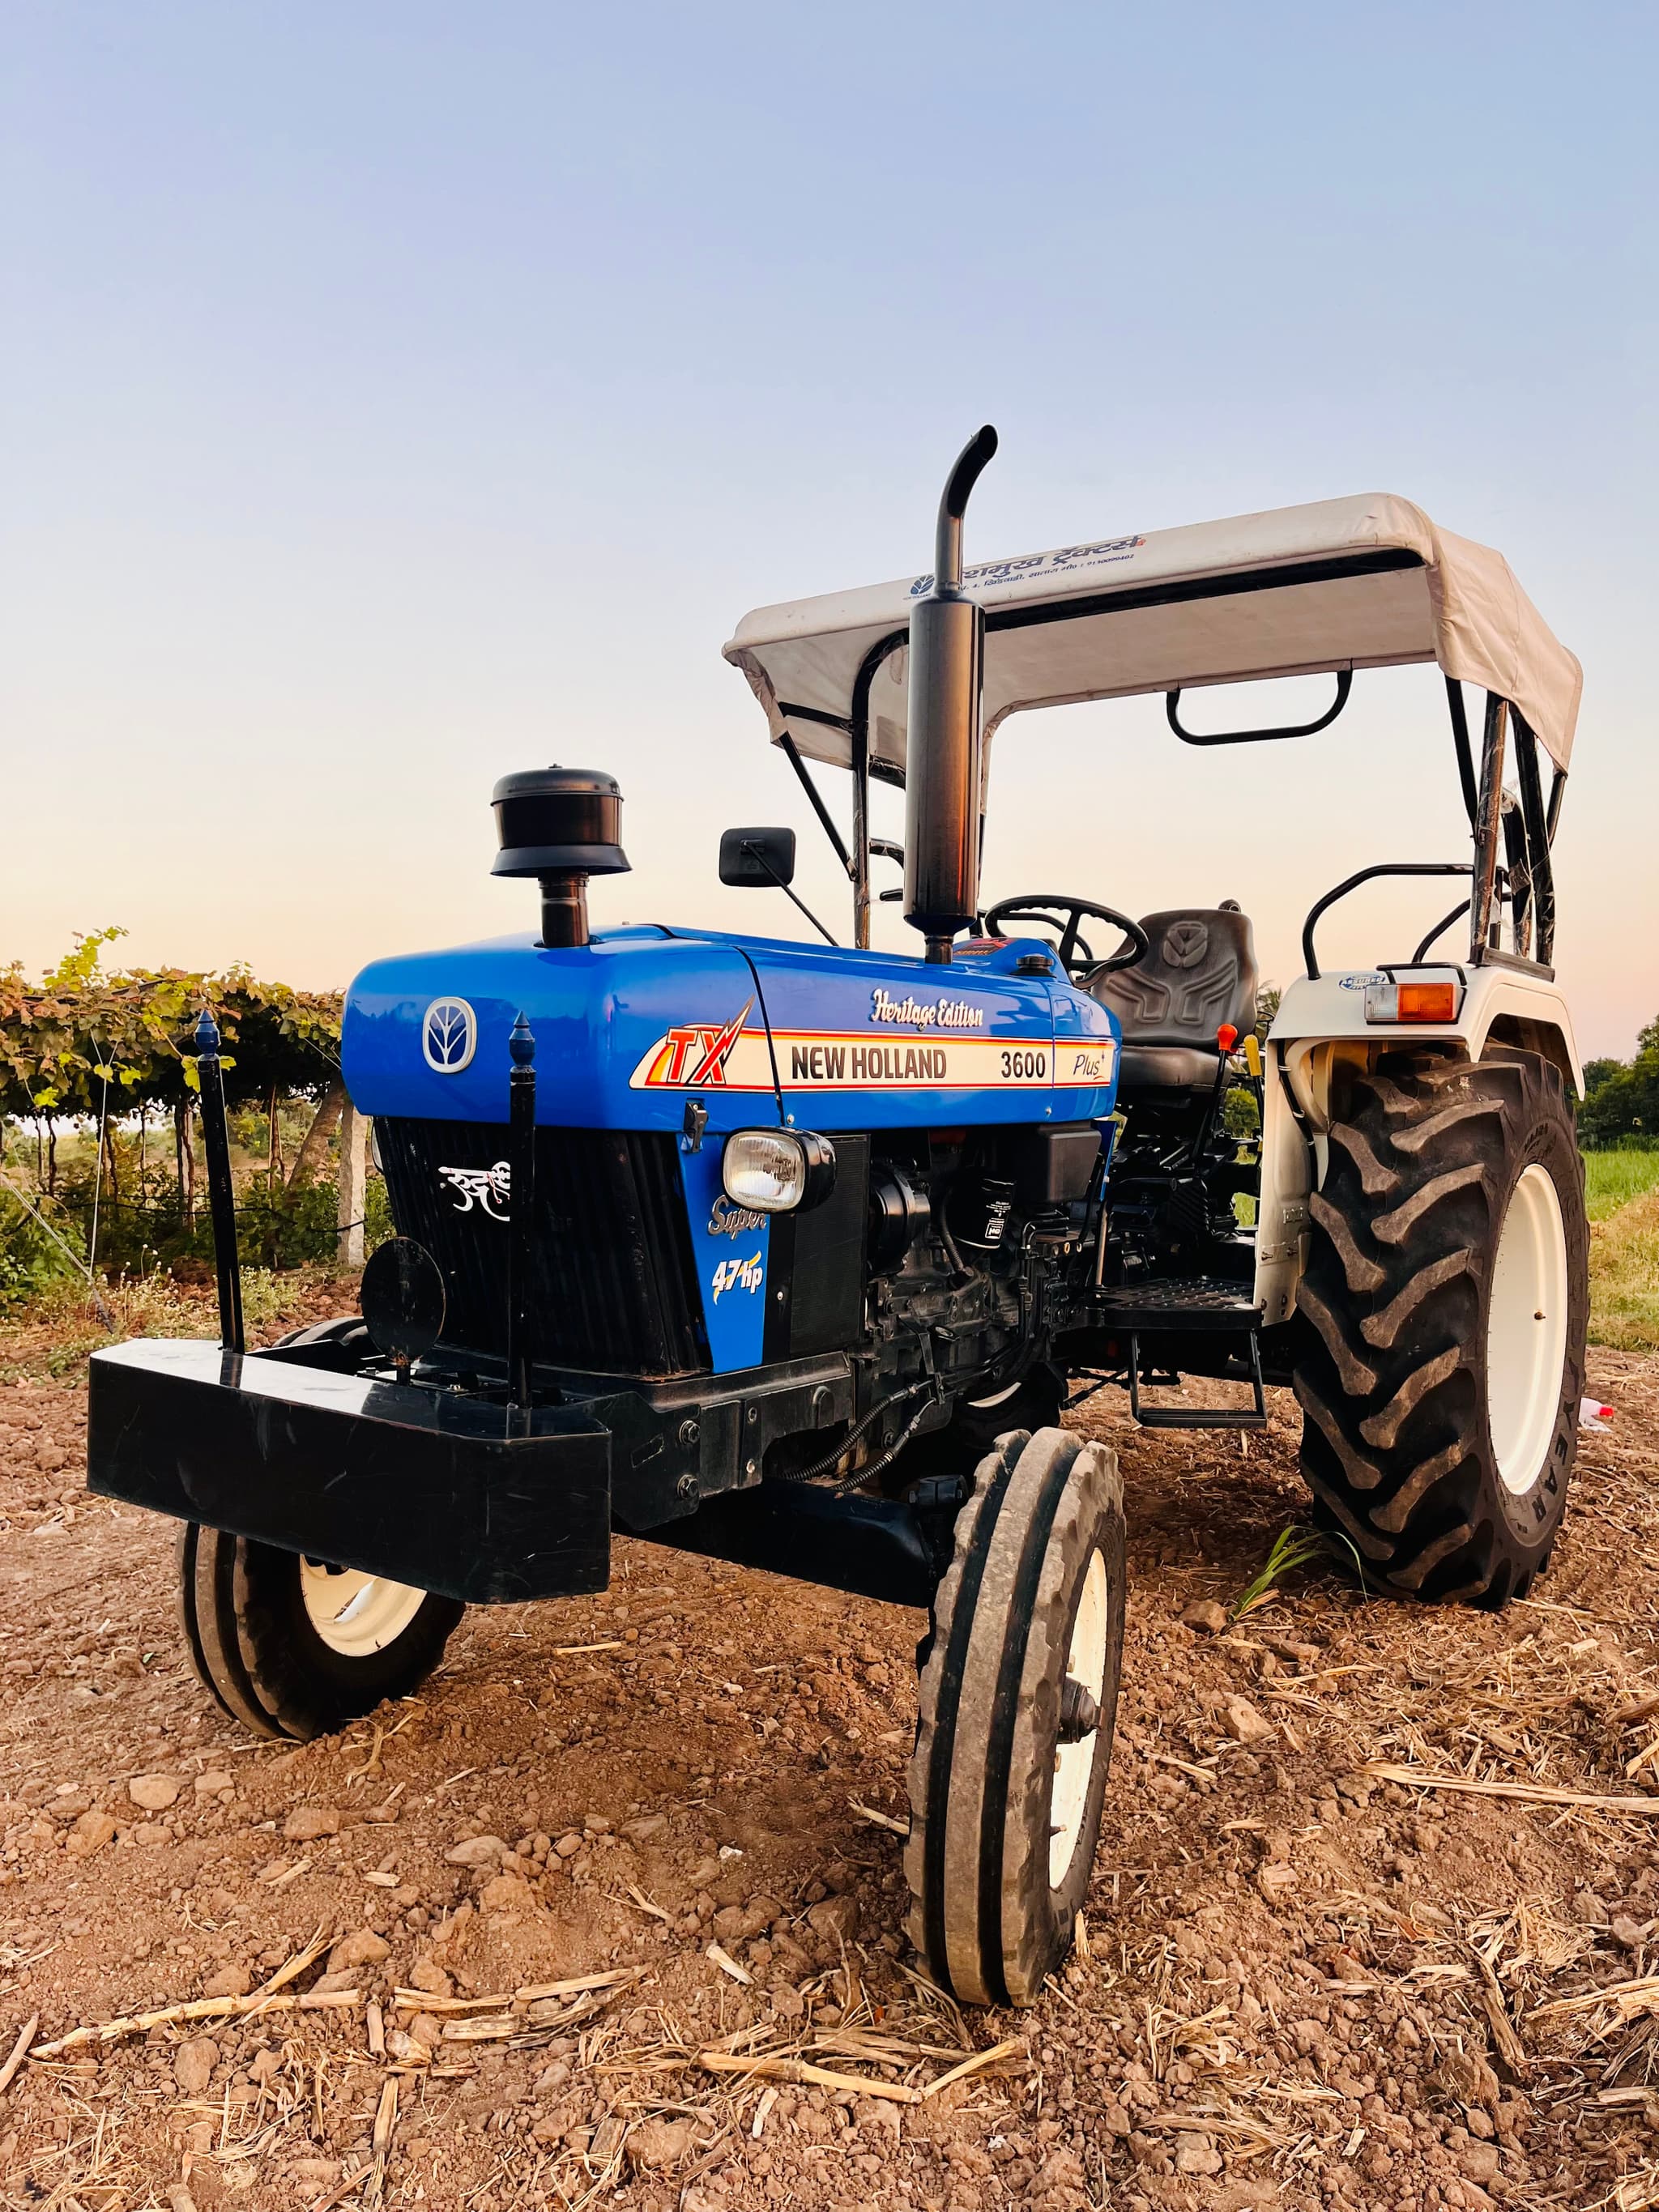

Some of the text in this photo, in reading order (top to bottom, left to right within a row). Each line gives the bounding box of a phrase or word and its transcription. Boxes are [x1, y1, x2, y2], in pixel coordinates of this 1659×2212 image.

[871, 988, 983, 1026] Heritage Edition
[666, 993, 756, 1087] TX
[792, 1046, 846, 1080] NEW
[851, 1047, 947, 1079] HOLLAND
[1001, 1051, 1046, 1078] 3600
[708, 1195, 766, 1240] Super
